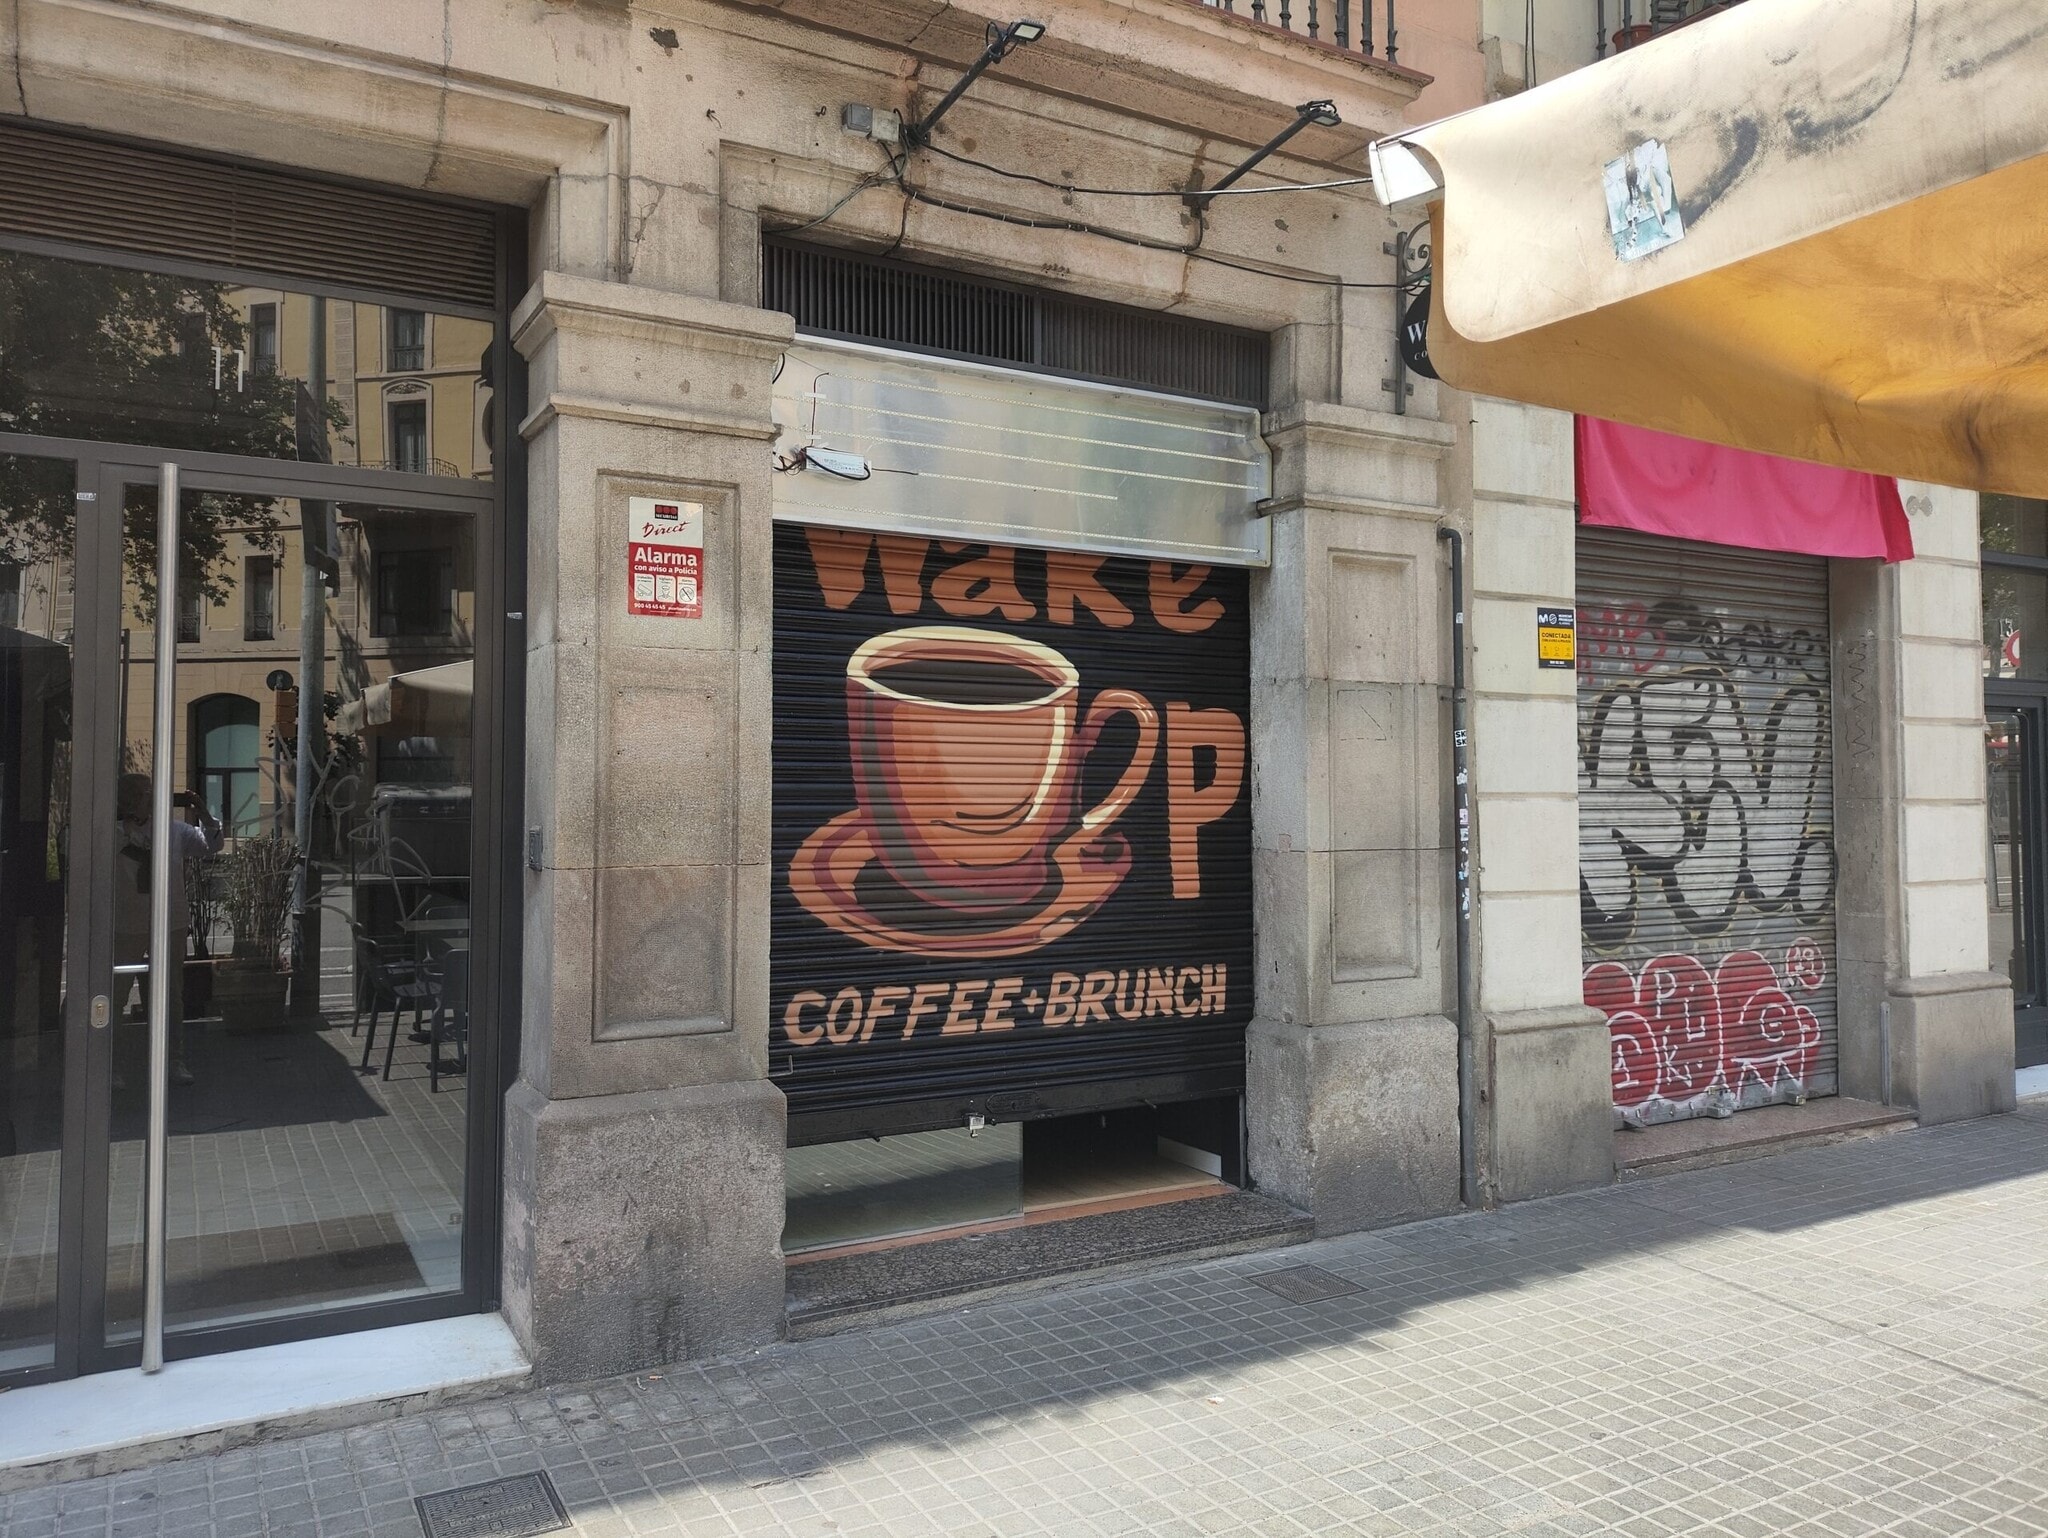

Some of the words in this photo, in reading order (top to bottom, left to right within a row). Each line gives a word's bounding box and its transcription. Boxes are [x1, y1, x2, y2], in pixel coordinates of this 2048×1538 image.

[210, 347, 244, 393] 11
[642, 521, 691, 538] Direct
[634, 546, 697, 567] Alarma
[648, 565, 667, 573] aviso
